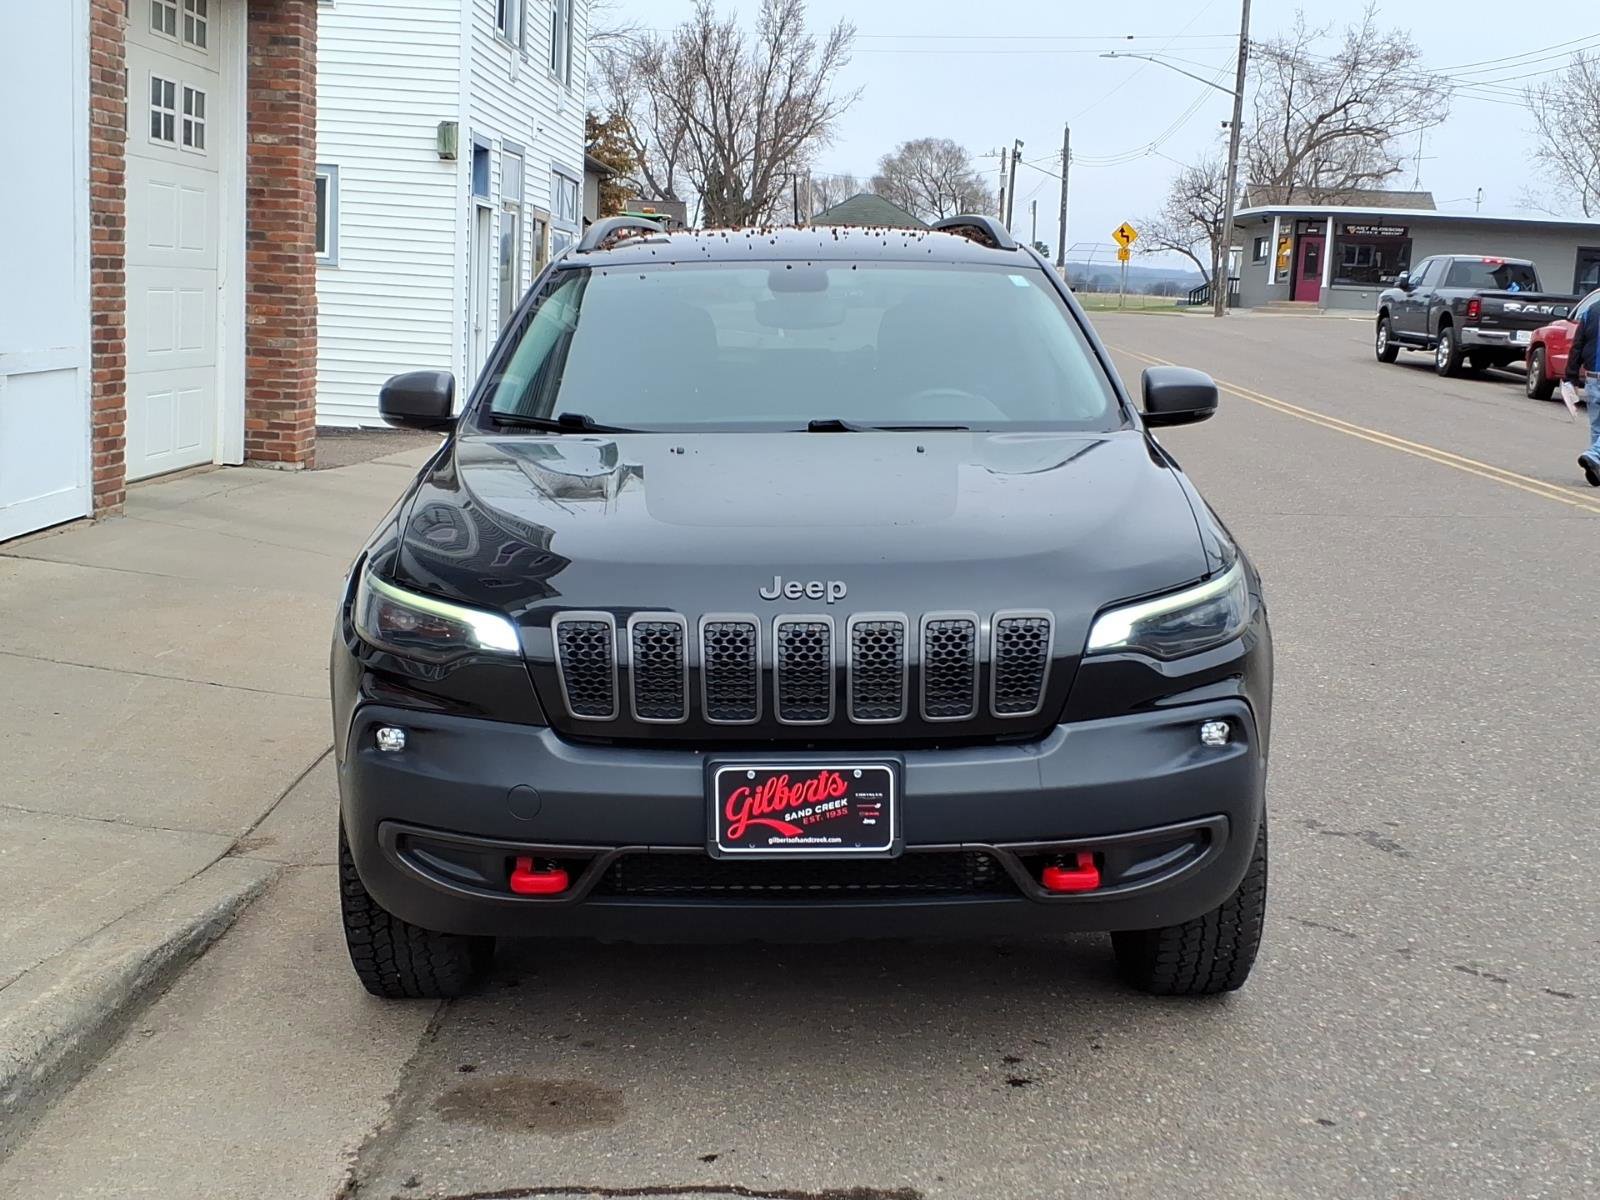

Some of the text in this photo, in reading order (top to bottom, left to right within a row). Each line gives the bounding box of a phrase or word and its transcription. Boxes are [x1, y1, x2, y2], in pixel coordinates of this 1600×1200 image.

[1503, 303, 1554, 314] RAM
[759, 575, 847, 604] Jeep
[726, 771, 848, 839] Gilberts
[784, 807, 813, 822] SAND
[815, 798, 848, 814] CREEK
[803, 814, 824, 825] EST.
[826, 807, 848, 820] 1935
